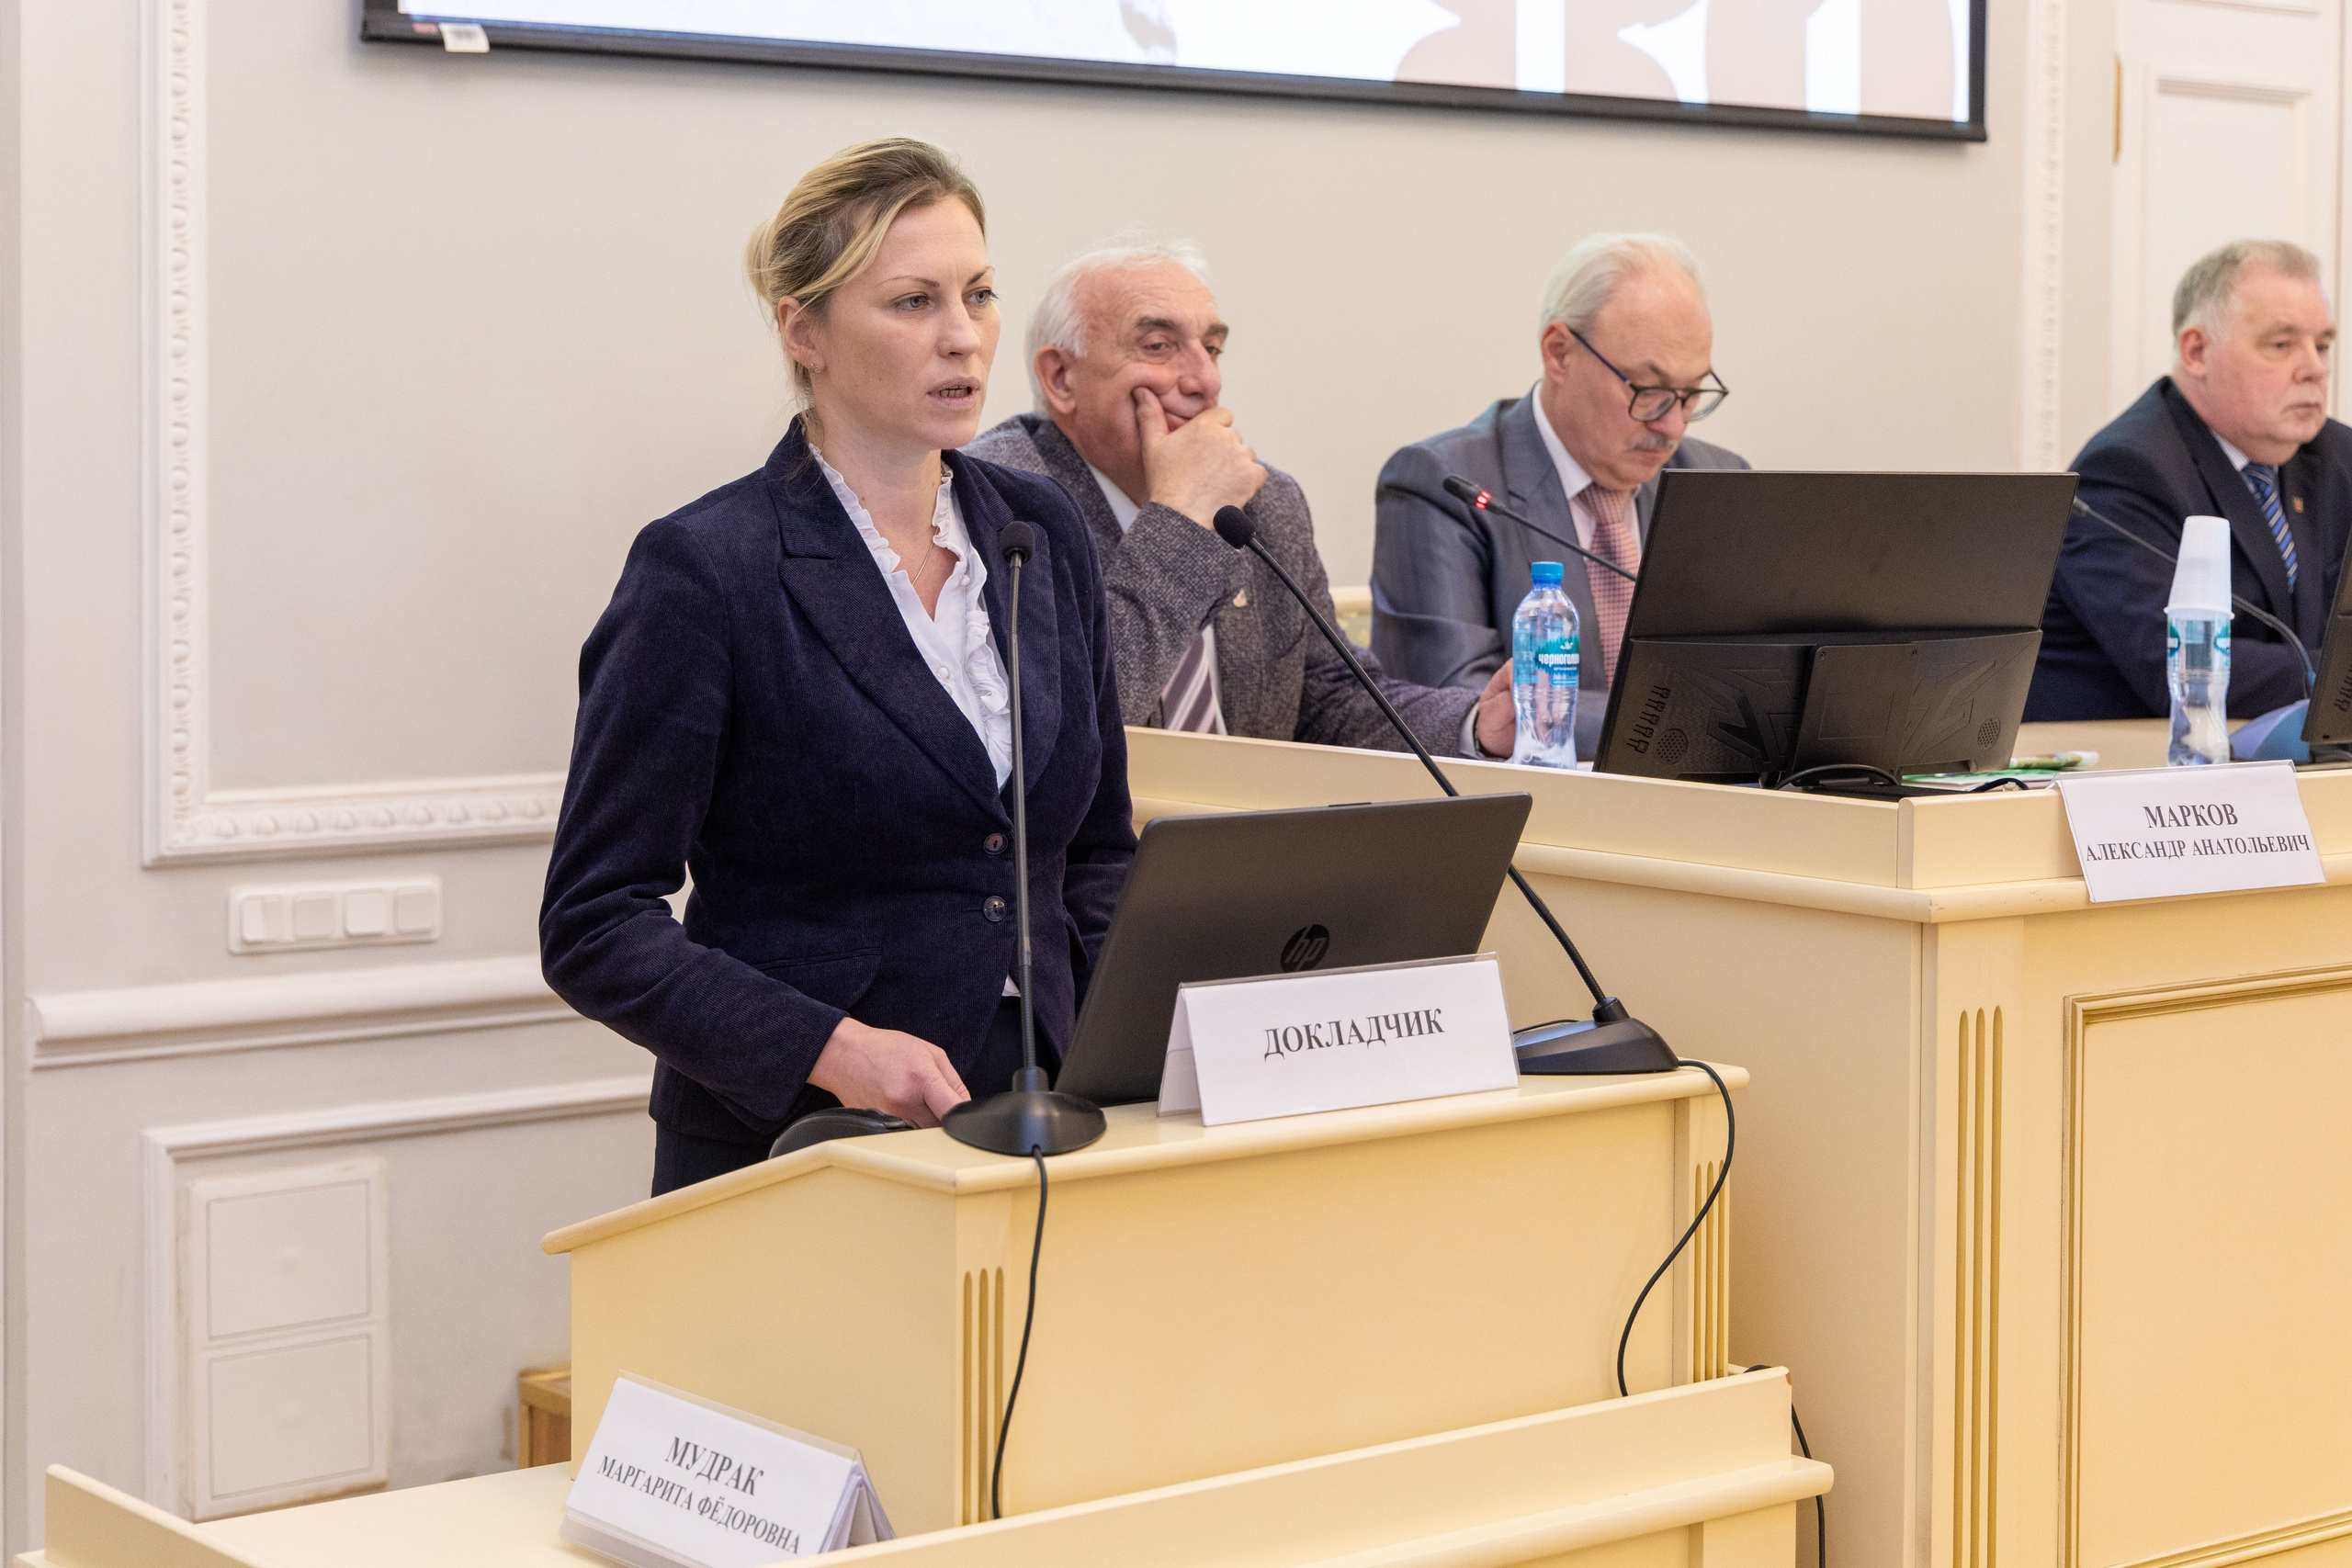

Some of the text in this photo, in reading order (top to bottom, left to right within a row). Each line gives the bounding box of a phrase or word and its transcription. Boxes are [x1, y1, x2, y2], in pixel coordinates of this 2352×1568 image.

[2143, 803, 2238, 829] МАРКОВ
[2086, 834, 2311, 862] АЛЕКСАНДР АНАТОЛЬЕВИЧ
[1283, 925, 1328, 972] hp
[1263, 1008, 1445, 1062] ДОКЛАДЧИК
[664, 1436, 764, 1496] МУДРАК
[597, 1455, 799, 1554] МАРГАРИТА ФЁДОРОВНА
